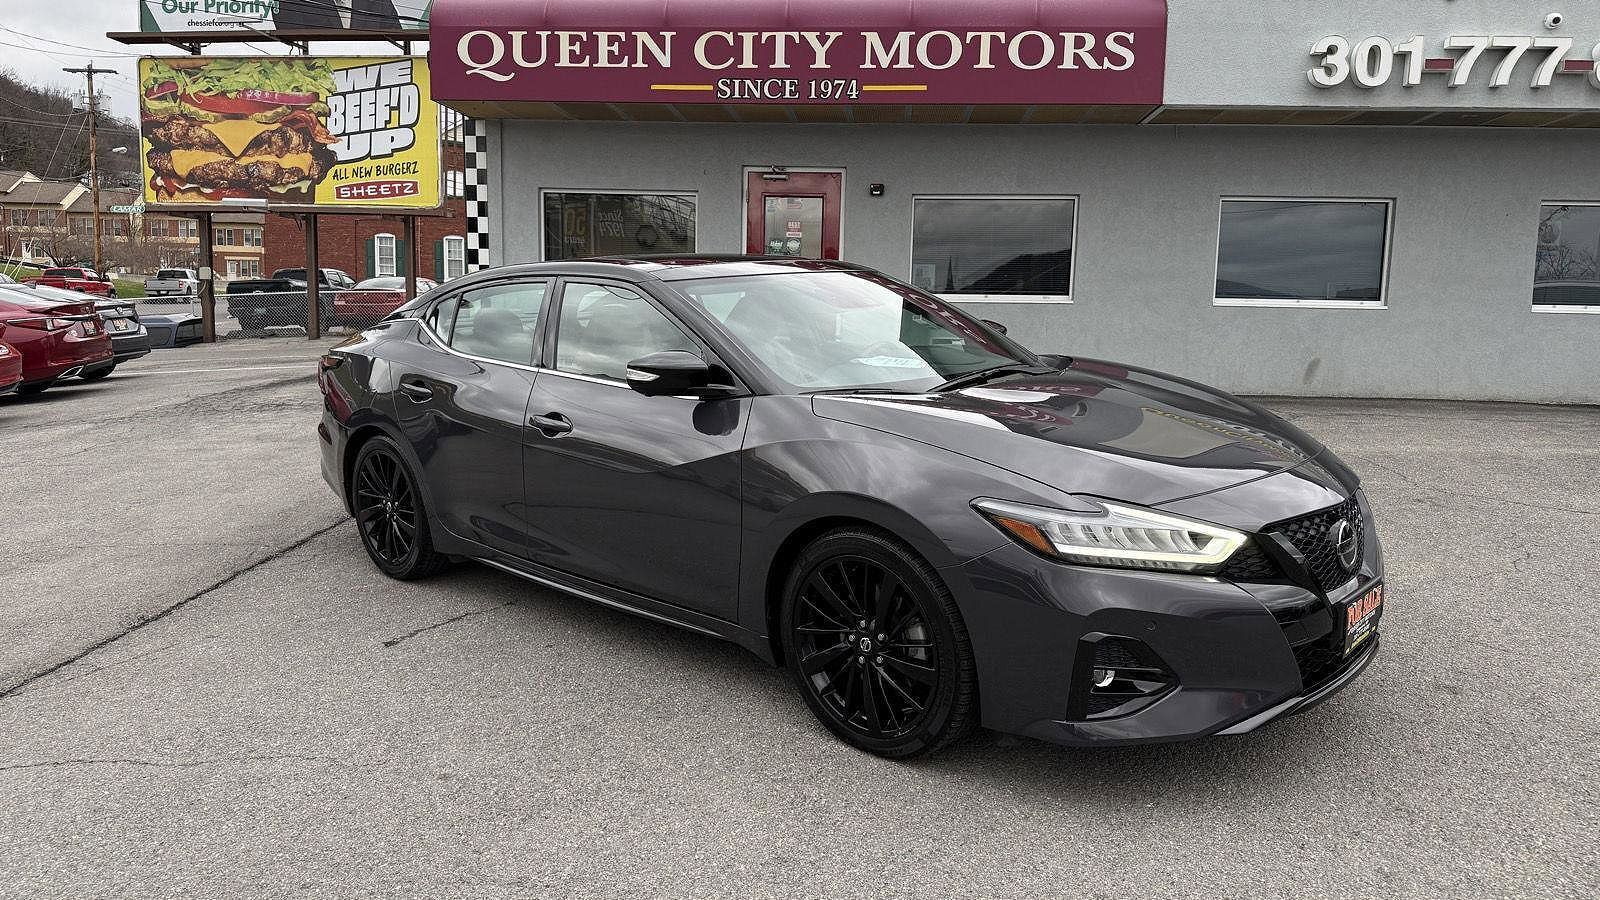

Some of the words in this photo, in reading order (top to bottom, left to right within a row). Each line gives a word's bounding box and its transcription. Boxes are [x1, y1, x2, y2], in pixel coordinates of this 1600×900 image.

[162, 0, 199, 14] Our
[456, 30, 678, 82] QUEEN
[693, 30, 843, 70] CITY
[859, 30, 1135, 71] MOTORS
[1306, 35, 1600, 89] 301-777-
[332, 60, 413, 93] WE
[716, 78, 799, 99] SINCE
[808, 79, 860, 99] 1974
[327, 84, 419, 136] BEEF'D
[328, 128, 415, 162] UP
[332, 168, 349, 181] ALL
[352, 165, 374, 179] NEW
[375, 161, 420, 176] BURGERZ
[340, 183, 415, 198] SHEETZ
